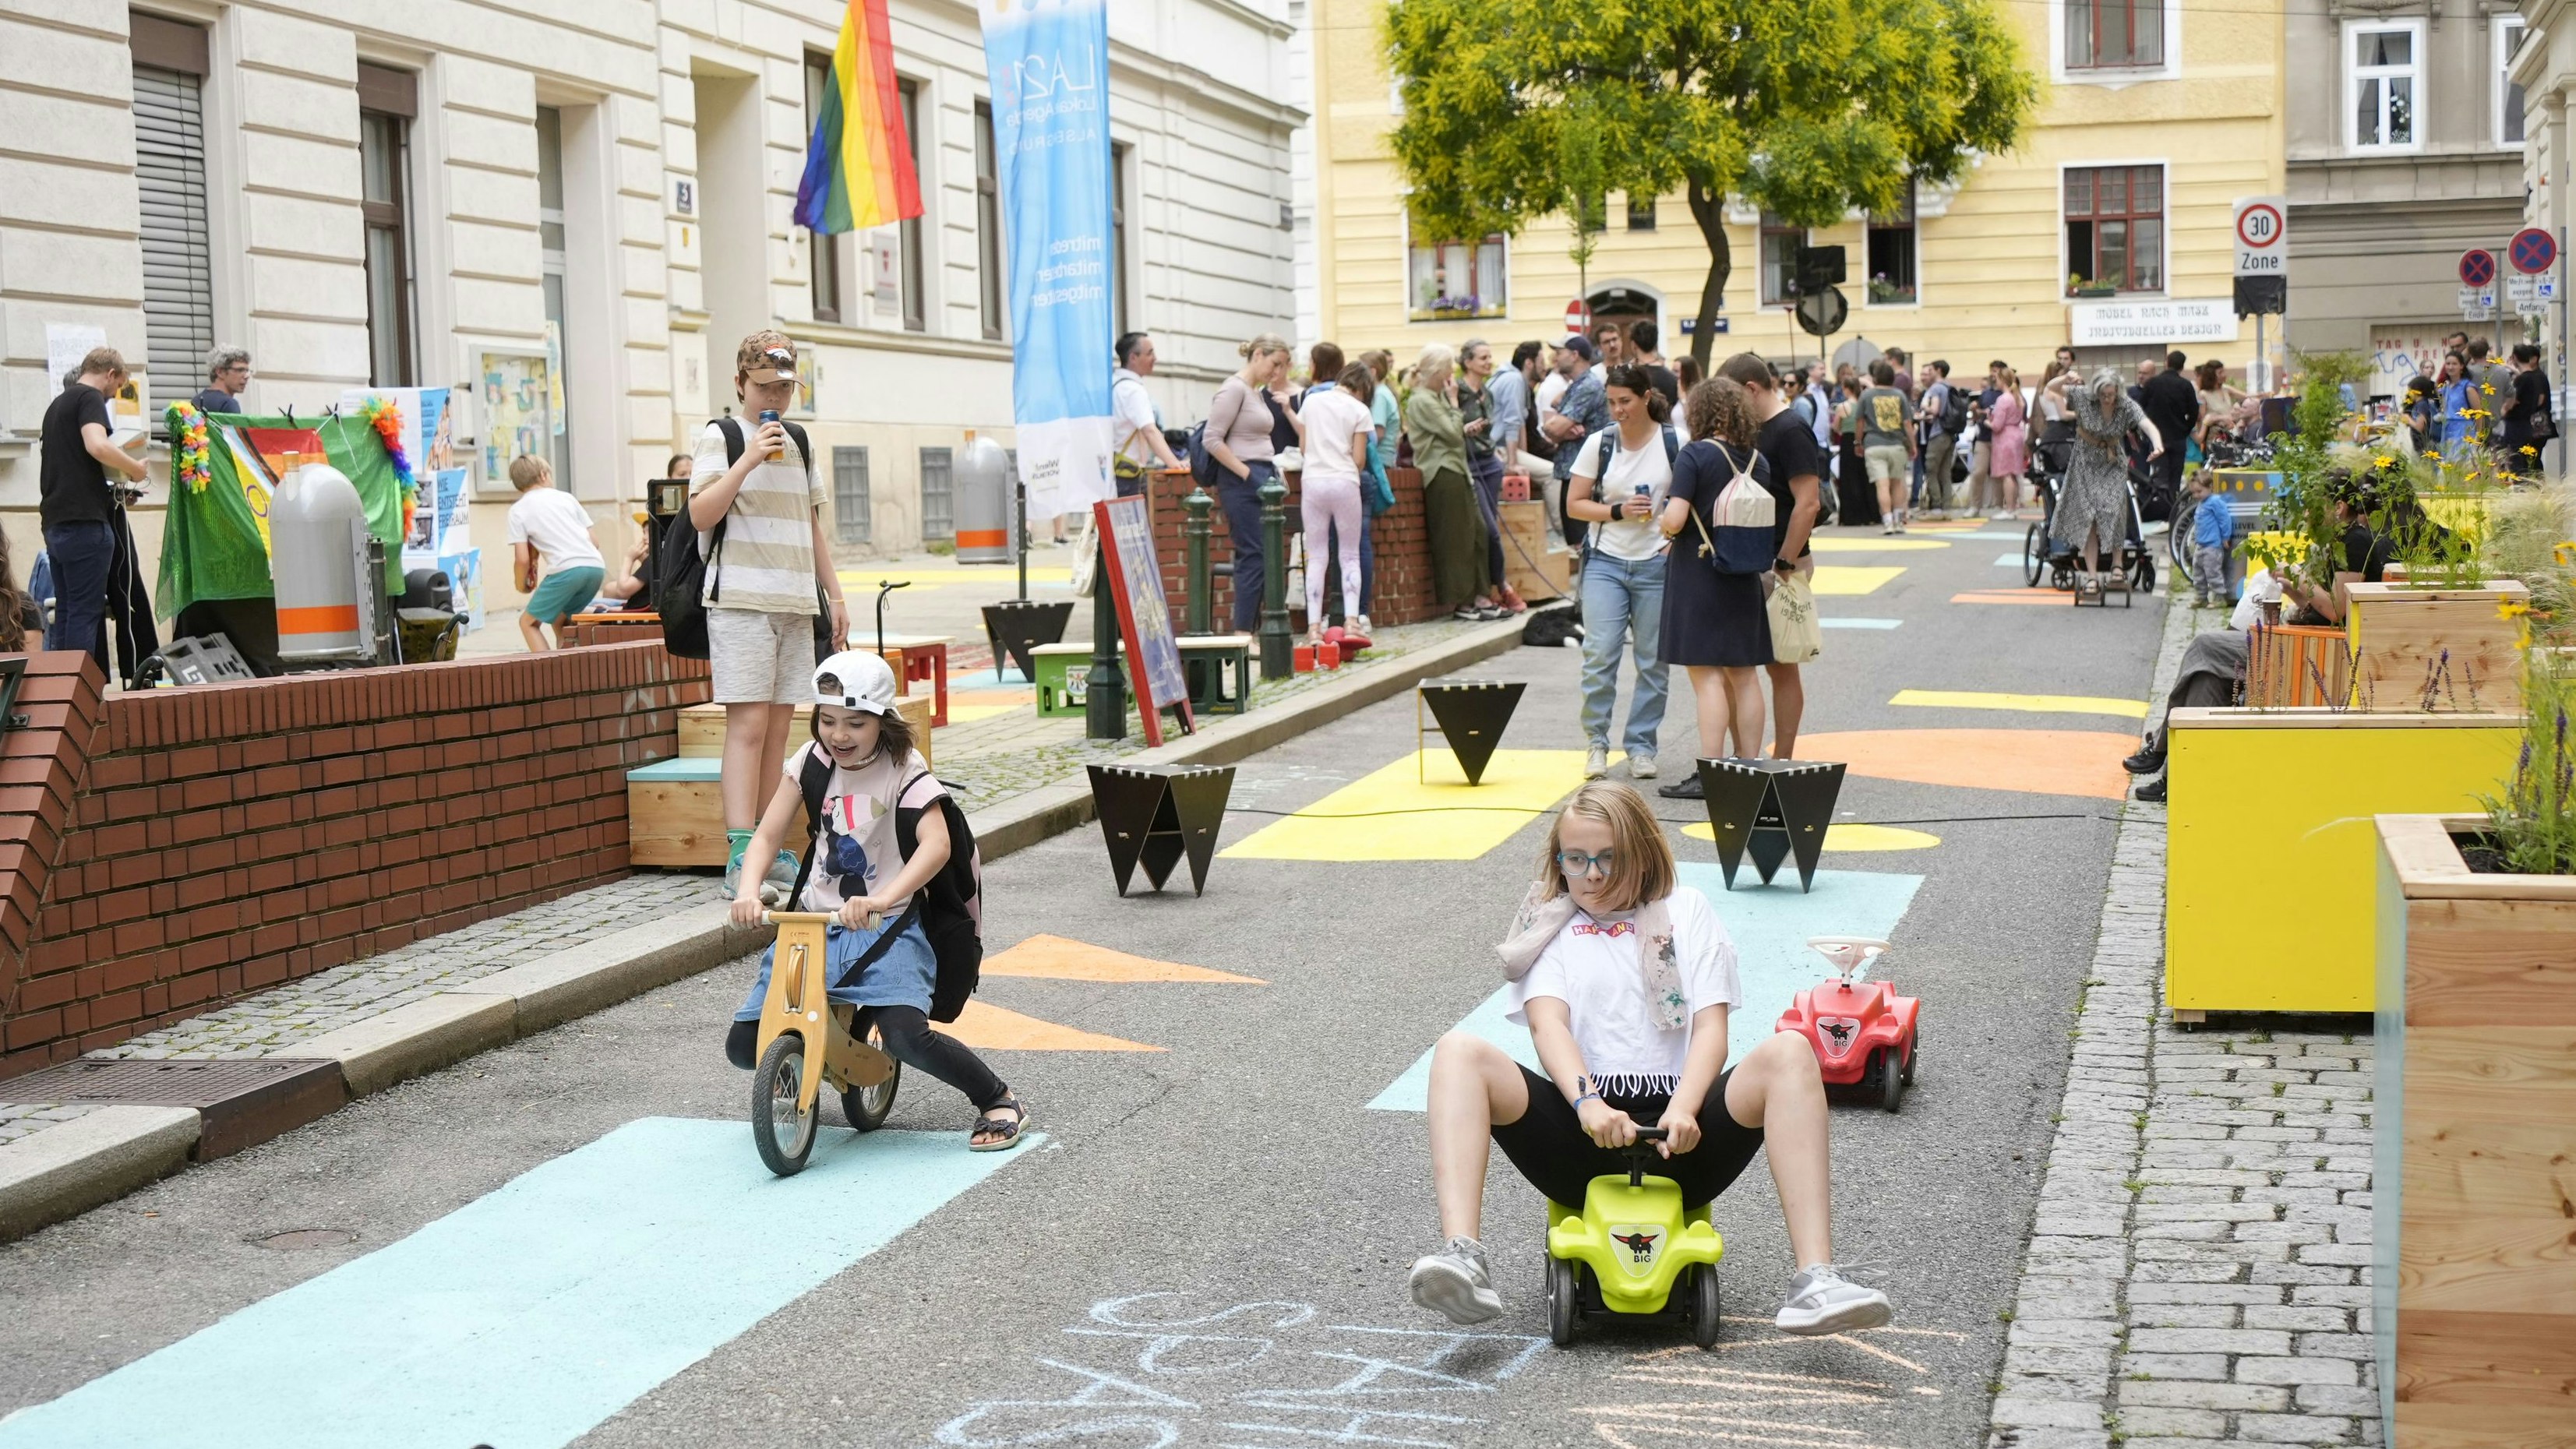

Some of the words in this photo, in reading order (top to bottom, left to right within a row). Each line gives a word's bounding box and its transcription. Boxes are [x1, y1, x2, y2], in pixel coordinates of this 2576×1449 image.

[2250, 216, 2269, 236] 30
[2241, 253, 2278, 270] Zone
[2087, 324, 2175, 338] INDIVIDUELLES
[2180, 323, 2222, 336] DESIGN
[2376, 339, 2403, 350] TAG
